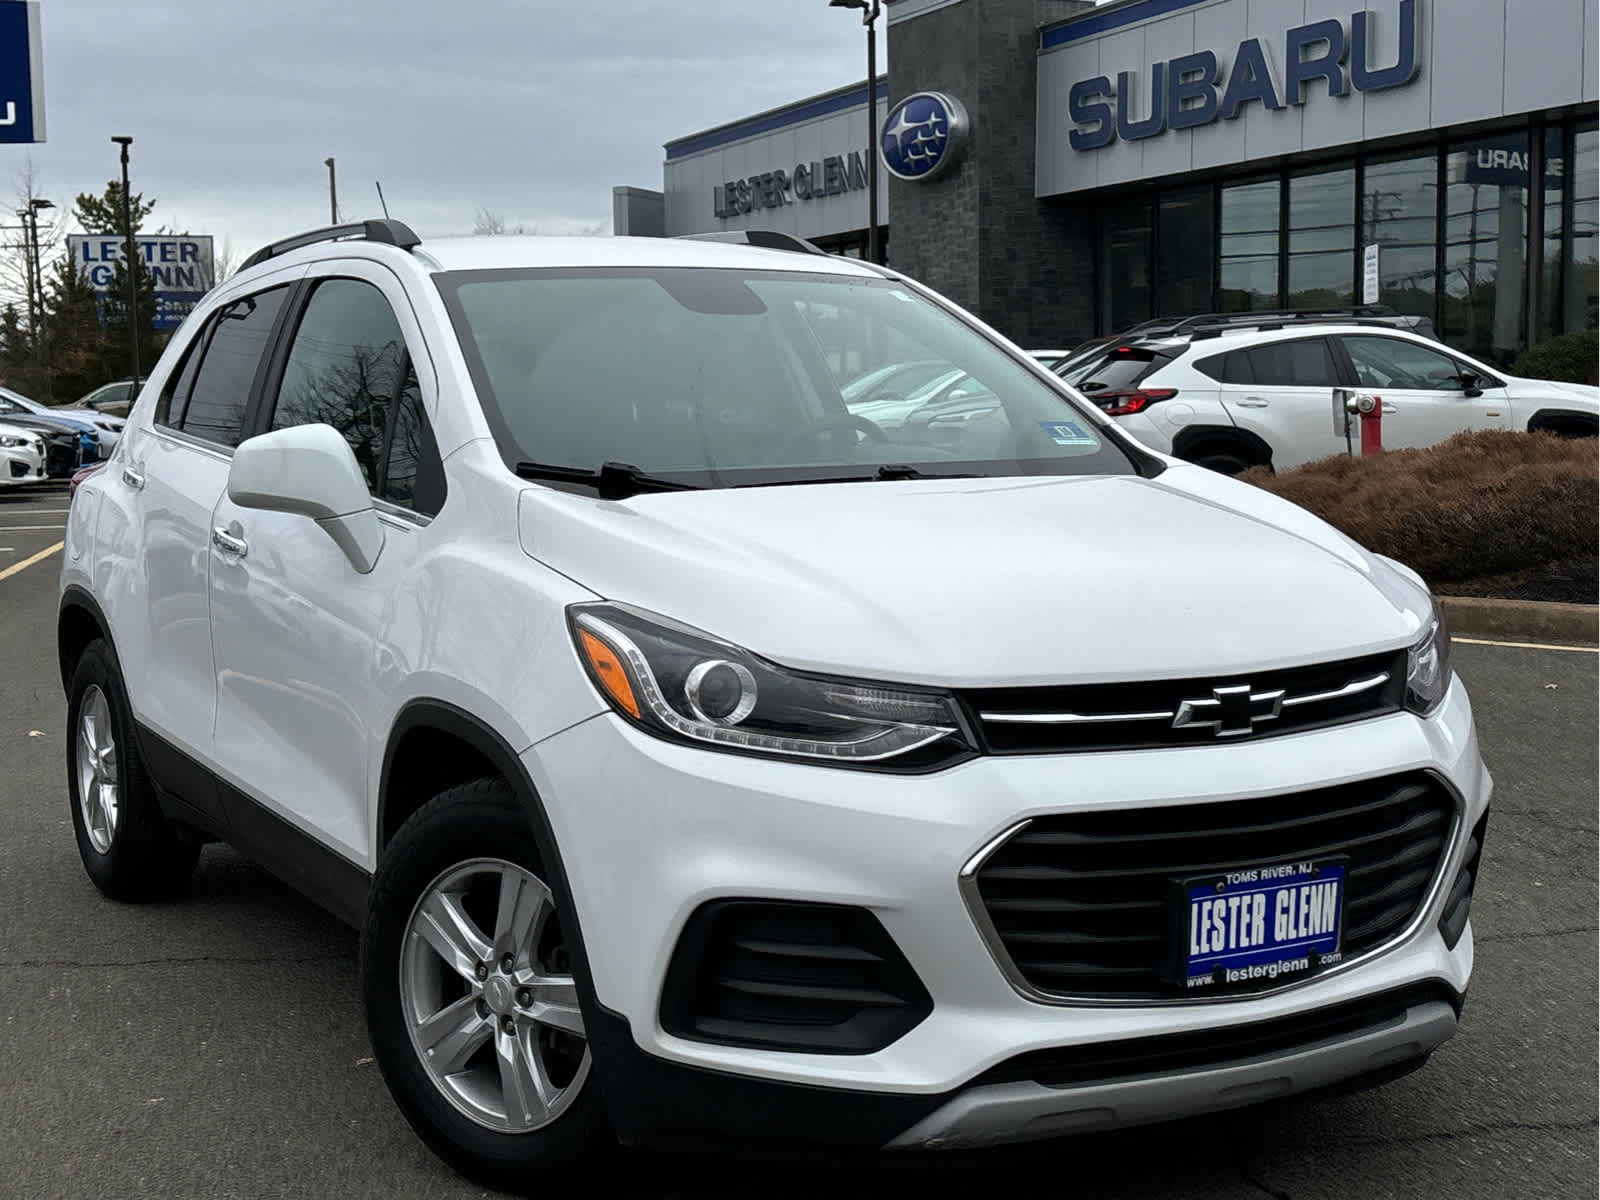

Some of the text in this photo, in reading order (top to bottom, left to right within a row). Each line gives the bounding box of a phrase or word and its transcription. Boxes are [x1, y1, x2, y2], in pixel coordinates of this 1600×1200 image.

[1069, 0, 1421, 152] SUBARU
[713, 149, 870, 219] LESTER GLENN
[91, 266, 194, 286] GNN
[1226, 870, 1258, 885] TOMS
[1299, 863, 1313, 873] NJ
[1190, 882, 1338, 955] LESTER GLENN
[1187, 976, 1215, 988] www.
[1226, 958, 1309, 983] lesterglenn
